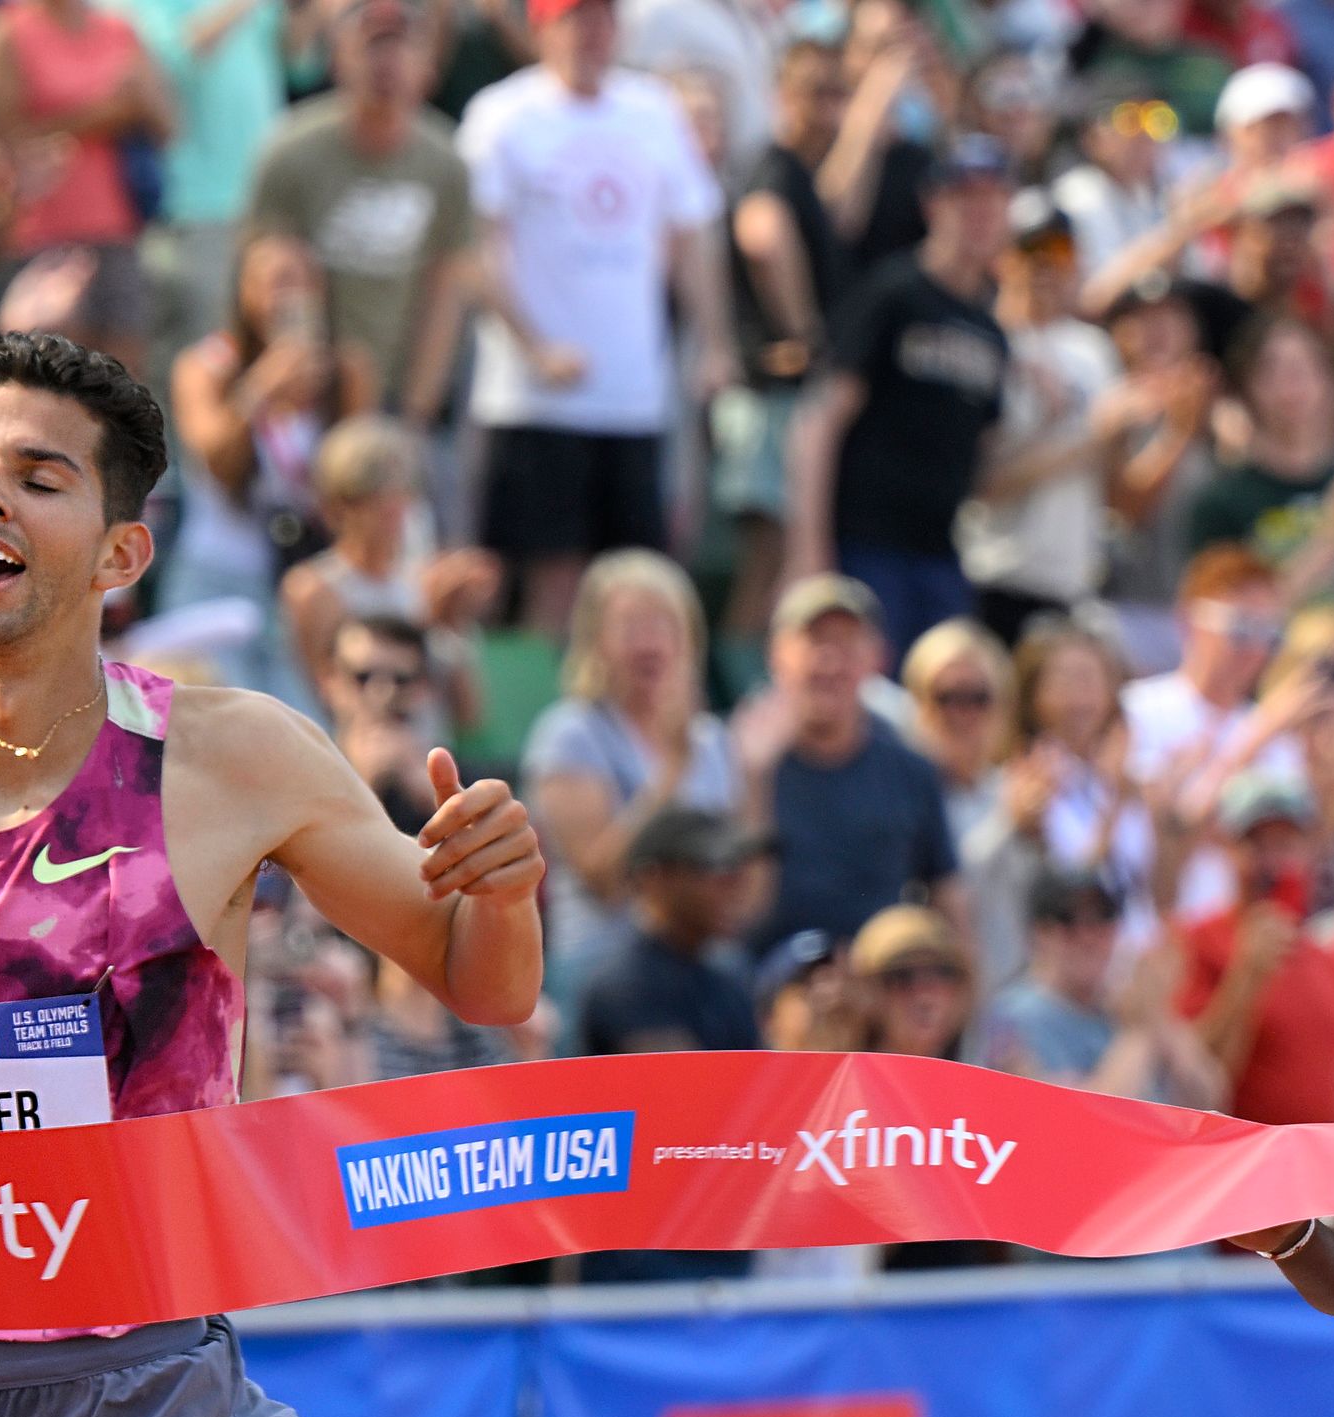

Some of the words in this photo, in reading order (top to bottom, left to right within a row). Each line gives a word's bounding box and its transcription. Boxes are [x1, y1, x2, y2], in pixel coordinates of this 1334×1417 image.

[12, 1012, 35, 1026] U.S.
[38, 1004, 88, 1023] OLYMPIC
[13, 1025, 47, 1041] TEAM
[48, 1019, 89, 1037] TRIALS
[17, 1041, 43, 1052] TRACK
[51, 1037, 72, 1049] FIELD
[346, 1146, 451, 1213] MAKING
[453, 1134, 535, 1195] TEAM
[544, 1127, 618, 1183] USA
[653, 1142, 755, 1165] presented
[758, 1141, 787, 1165] by
[794, 1109, 1019, 1187] xfinity
